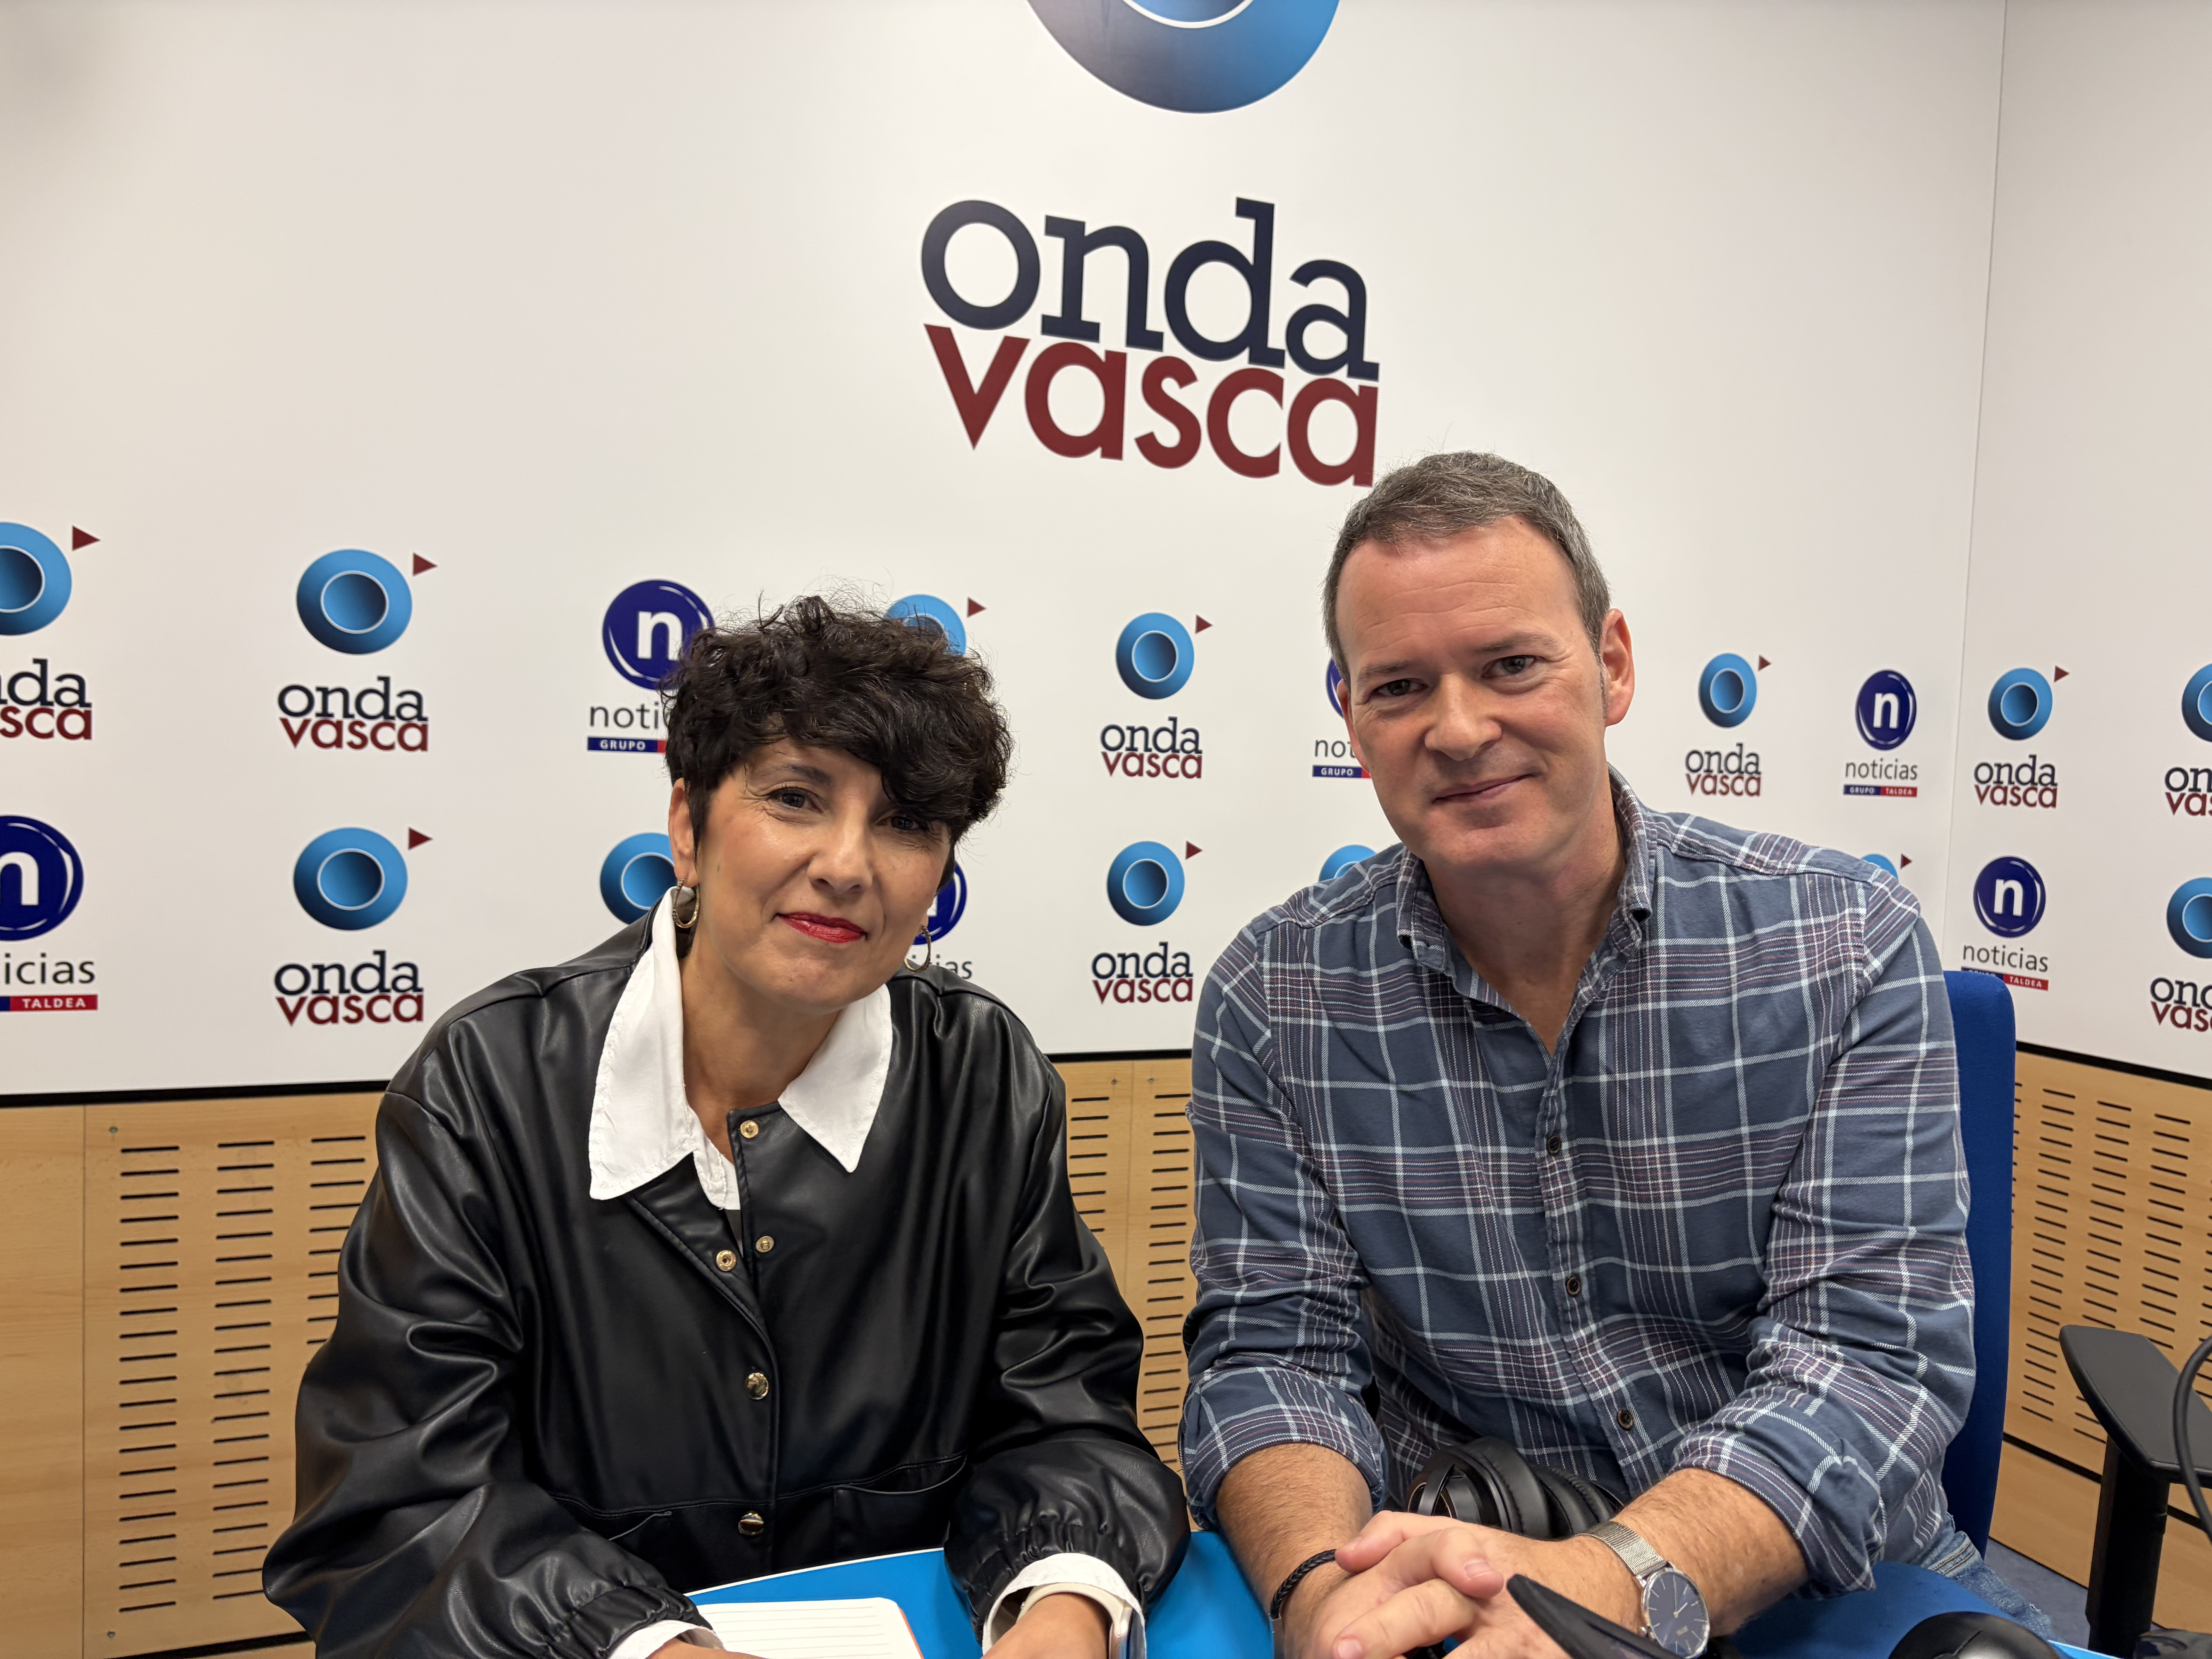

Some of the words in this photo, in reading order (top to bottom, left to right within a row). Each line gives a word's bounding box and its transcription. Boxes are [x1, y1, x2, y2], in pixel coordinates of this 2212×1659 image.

[921, 197, 1379, 382] onda
[924, 323, 1379, 487] vasca
[0, 658, 92, 708] da
[277, 675, 428, 722] onda
[0, 706, 92, 740] sca
[590, 701, 659, 730] noti
[1873, 692, 1899, 729] n
[279, 718, 428, 752] vasca
[600, 739, 646, 751] GRUPO
[1100, 716, 1203, 754] onda
[1102, 751, 1203, 779] vasca
[1321, 768, 1353, 776] GRUPO
[1685, 742, 1762, 775] onda
[1845, 757, 1918, 781] noticias
[1974, 754, 2058, 787] onda
[1686, 774, 1761, 797] vasca
[1850, 786, 1875, 794] GRUPO
[1974, 785, 2058, 808] vasca
[2164, 767, 2212, 793] on
[1994, 879, 2023, 916] n
[4, 952, 96, 985] icias
[273, 950, 424, 996] onda
[1091, 941, 1194, 979] onda
[1963, 944, 2049, 972] noticias
[1092, 978, 1194, 1004] vasca
[2009, 976, 2042, 988] TALDEA
[22, 997, 86, 1008] TALDEA
[275, 993, 424, 1026] vasca
[2150, 1001, 2212, 1032] vas
